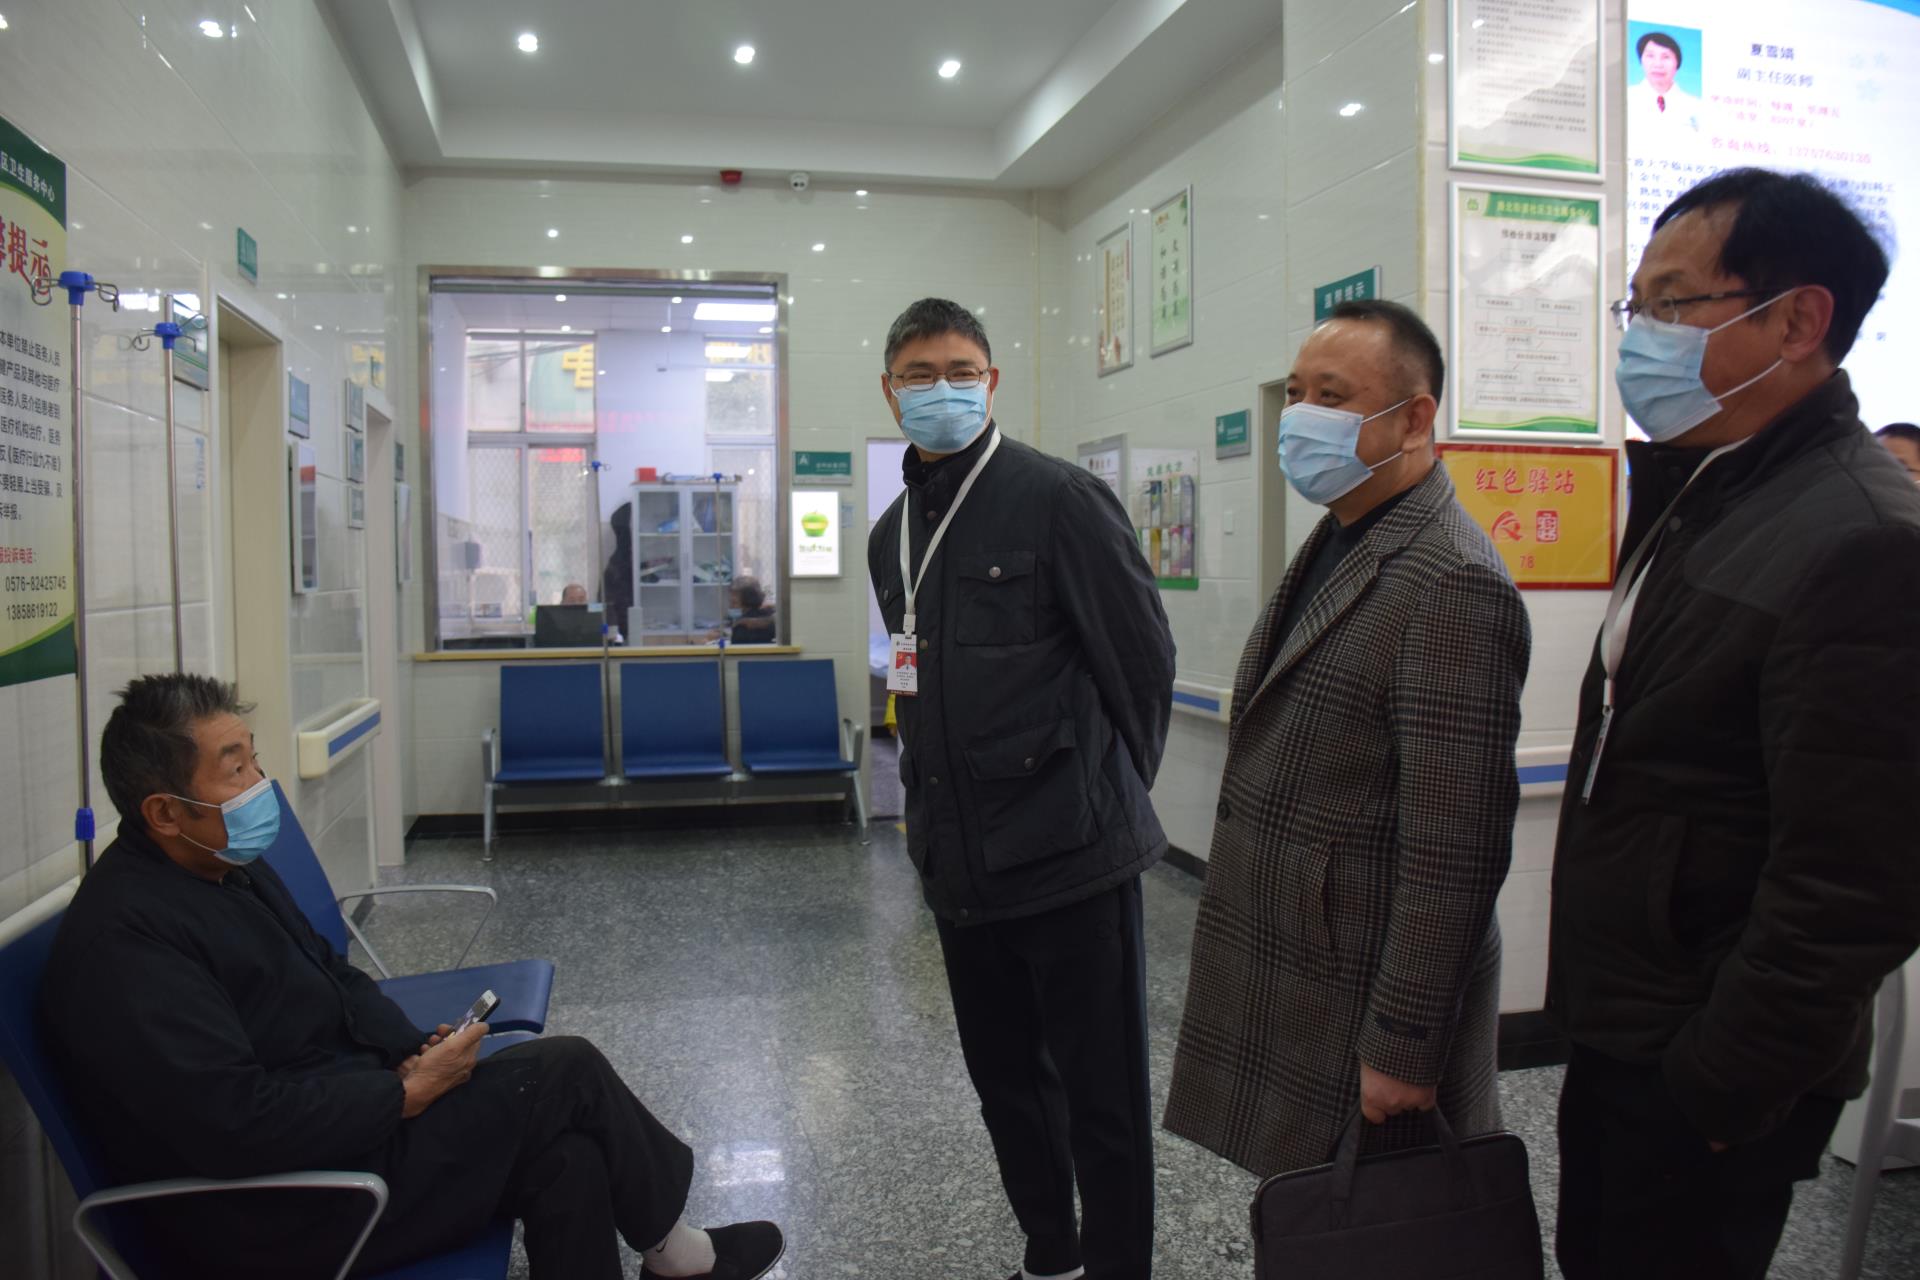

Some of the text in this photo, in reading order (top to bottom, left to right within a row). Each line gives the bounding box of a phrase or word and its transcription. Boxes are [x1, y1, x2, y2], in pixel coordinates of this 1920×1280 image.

[0, 150, 55, 202] 区卫生服务中心
[1475, 467, 1575, 494] 红色驿站
[1520, 555, 1536, 569] 78
